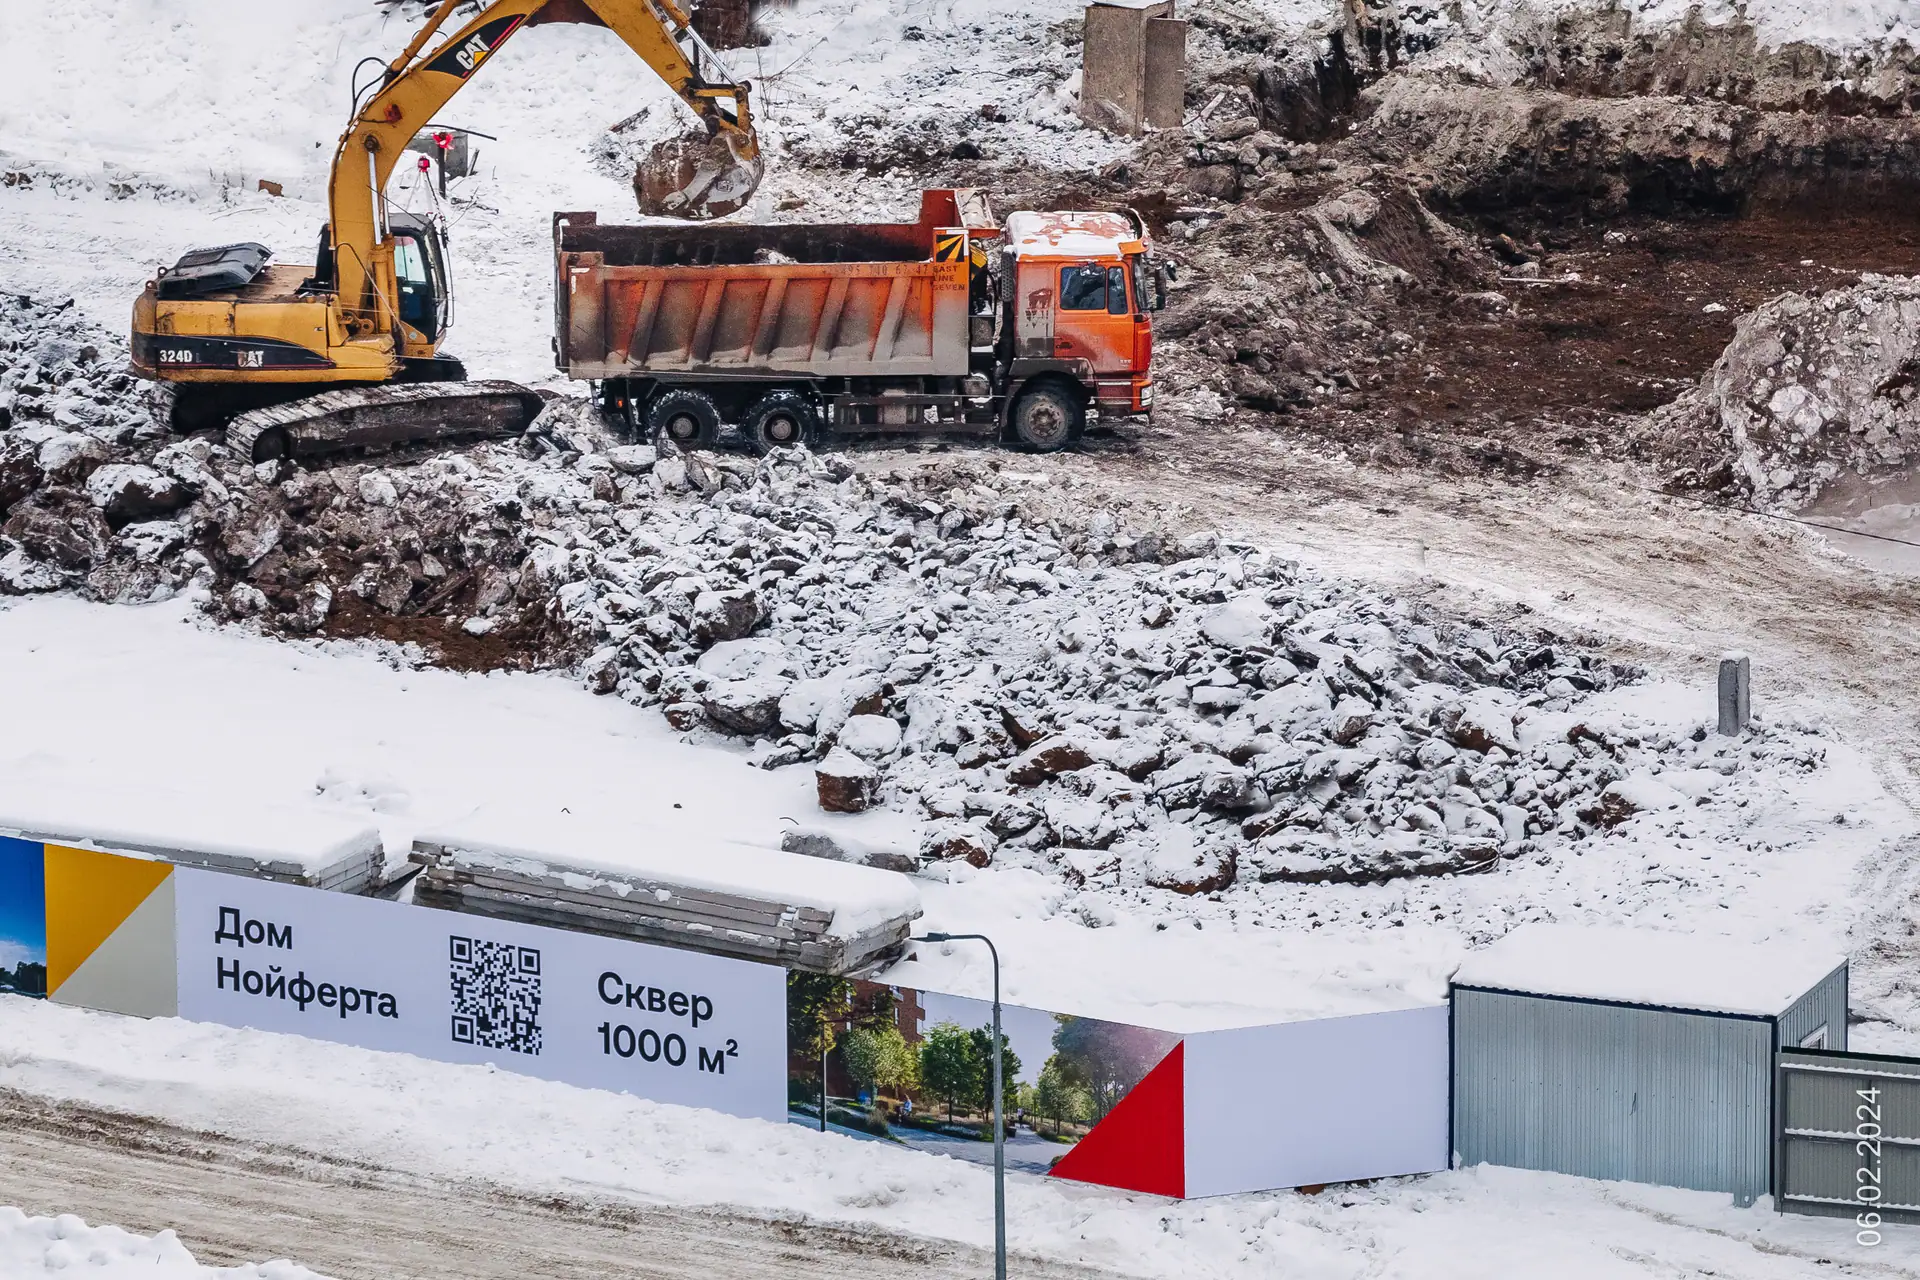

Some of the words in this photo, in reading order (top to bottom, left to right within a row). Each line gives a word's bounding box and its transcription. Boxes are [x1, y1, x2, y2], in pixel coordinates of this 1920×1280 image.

[456, 34, 490, 70] CAT
[160, 350, 193, 363] 324D
[237, 349, 264, 368] CAT
[215, 906, 293, 950] Дом
[217, 957, 399, 1019] Нойферта
[597, 971, 713, 1028] Сквер
[597, 1022, 687, 1067] 1000
